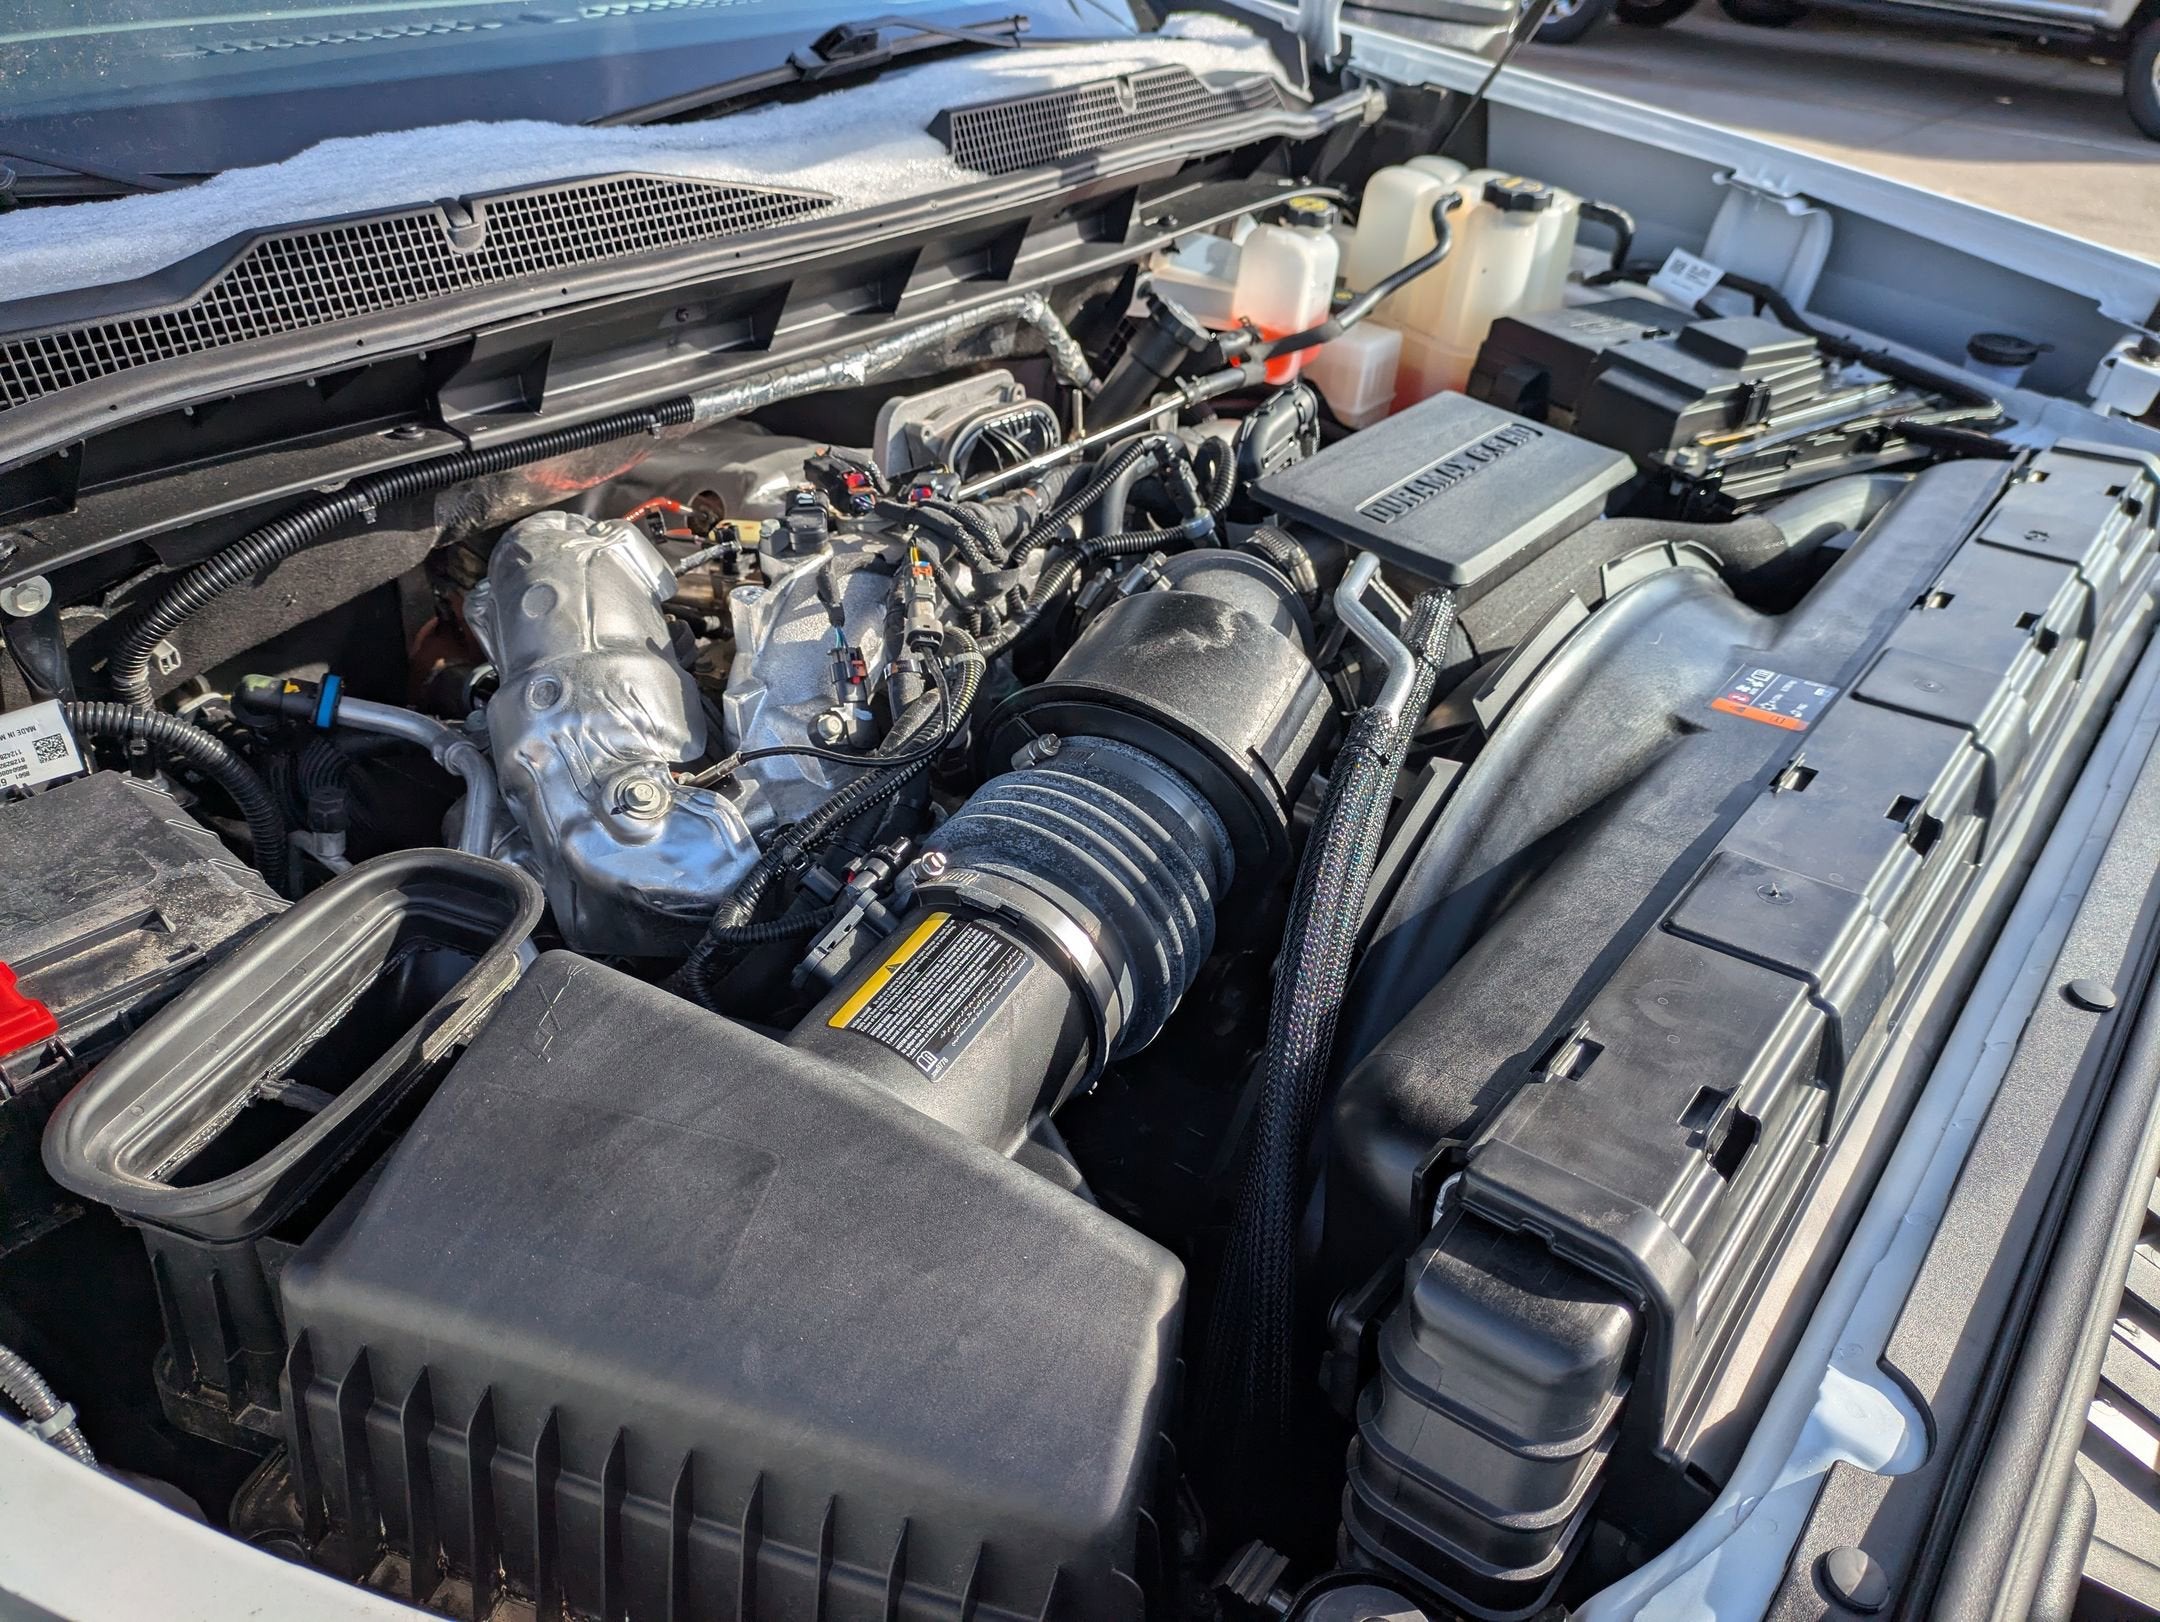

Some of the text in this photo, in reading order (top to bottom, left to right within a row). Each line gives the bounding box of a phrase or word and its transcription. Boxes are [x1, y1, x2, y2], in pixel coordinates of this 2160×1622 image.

[1361, 457, 1478, 525] DURAMAX
[7, 731, 15, 739] IN
[17, 725, 36, 736] MADE
